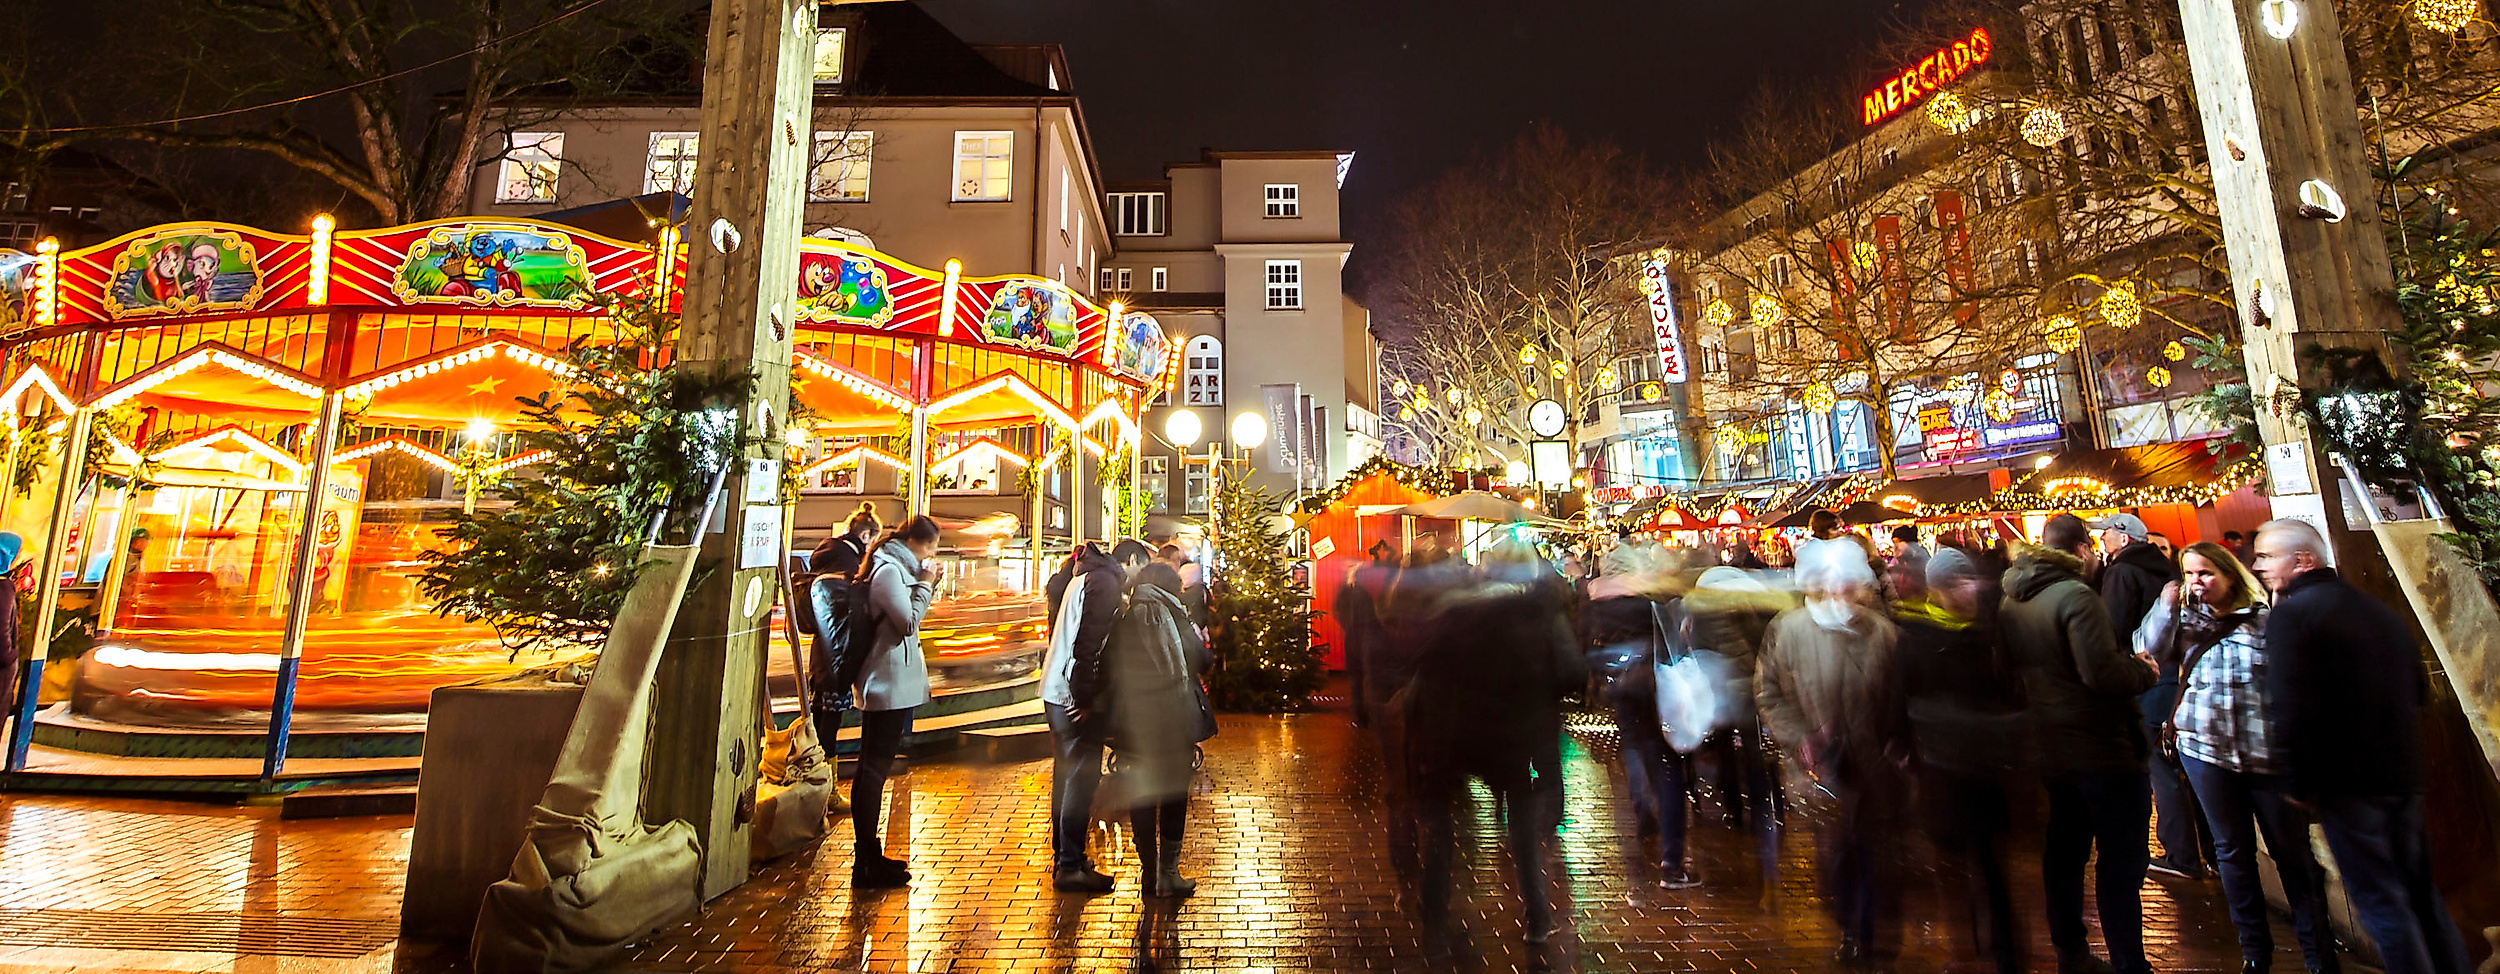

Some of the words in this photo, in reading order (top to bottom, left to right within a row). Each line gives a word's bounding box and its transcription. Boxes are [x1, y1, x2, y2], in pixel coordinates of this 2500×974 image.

[1863, 27, 1991, 126] MERCADO
[1918, 408, 1951, 432] DAK
[1596, 485, 1664, 503] MERCDO
